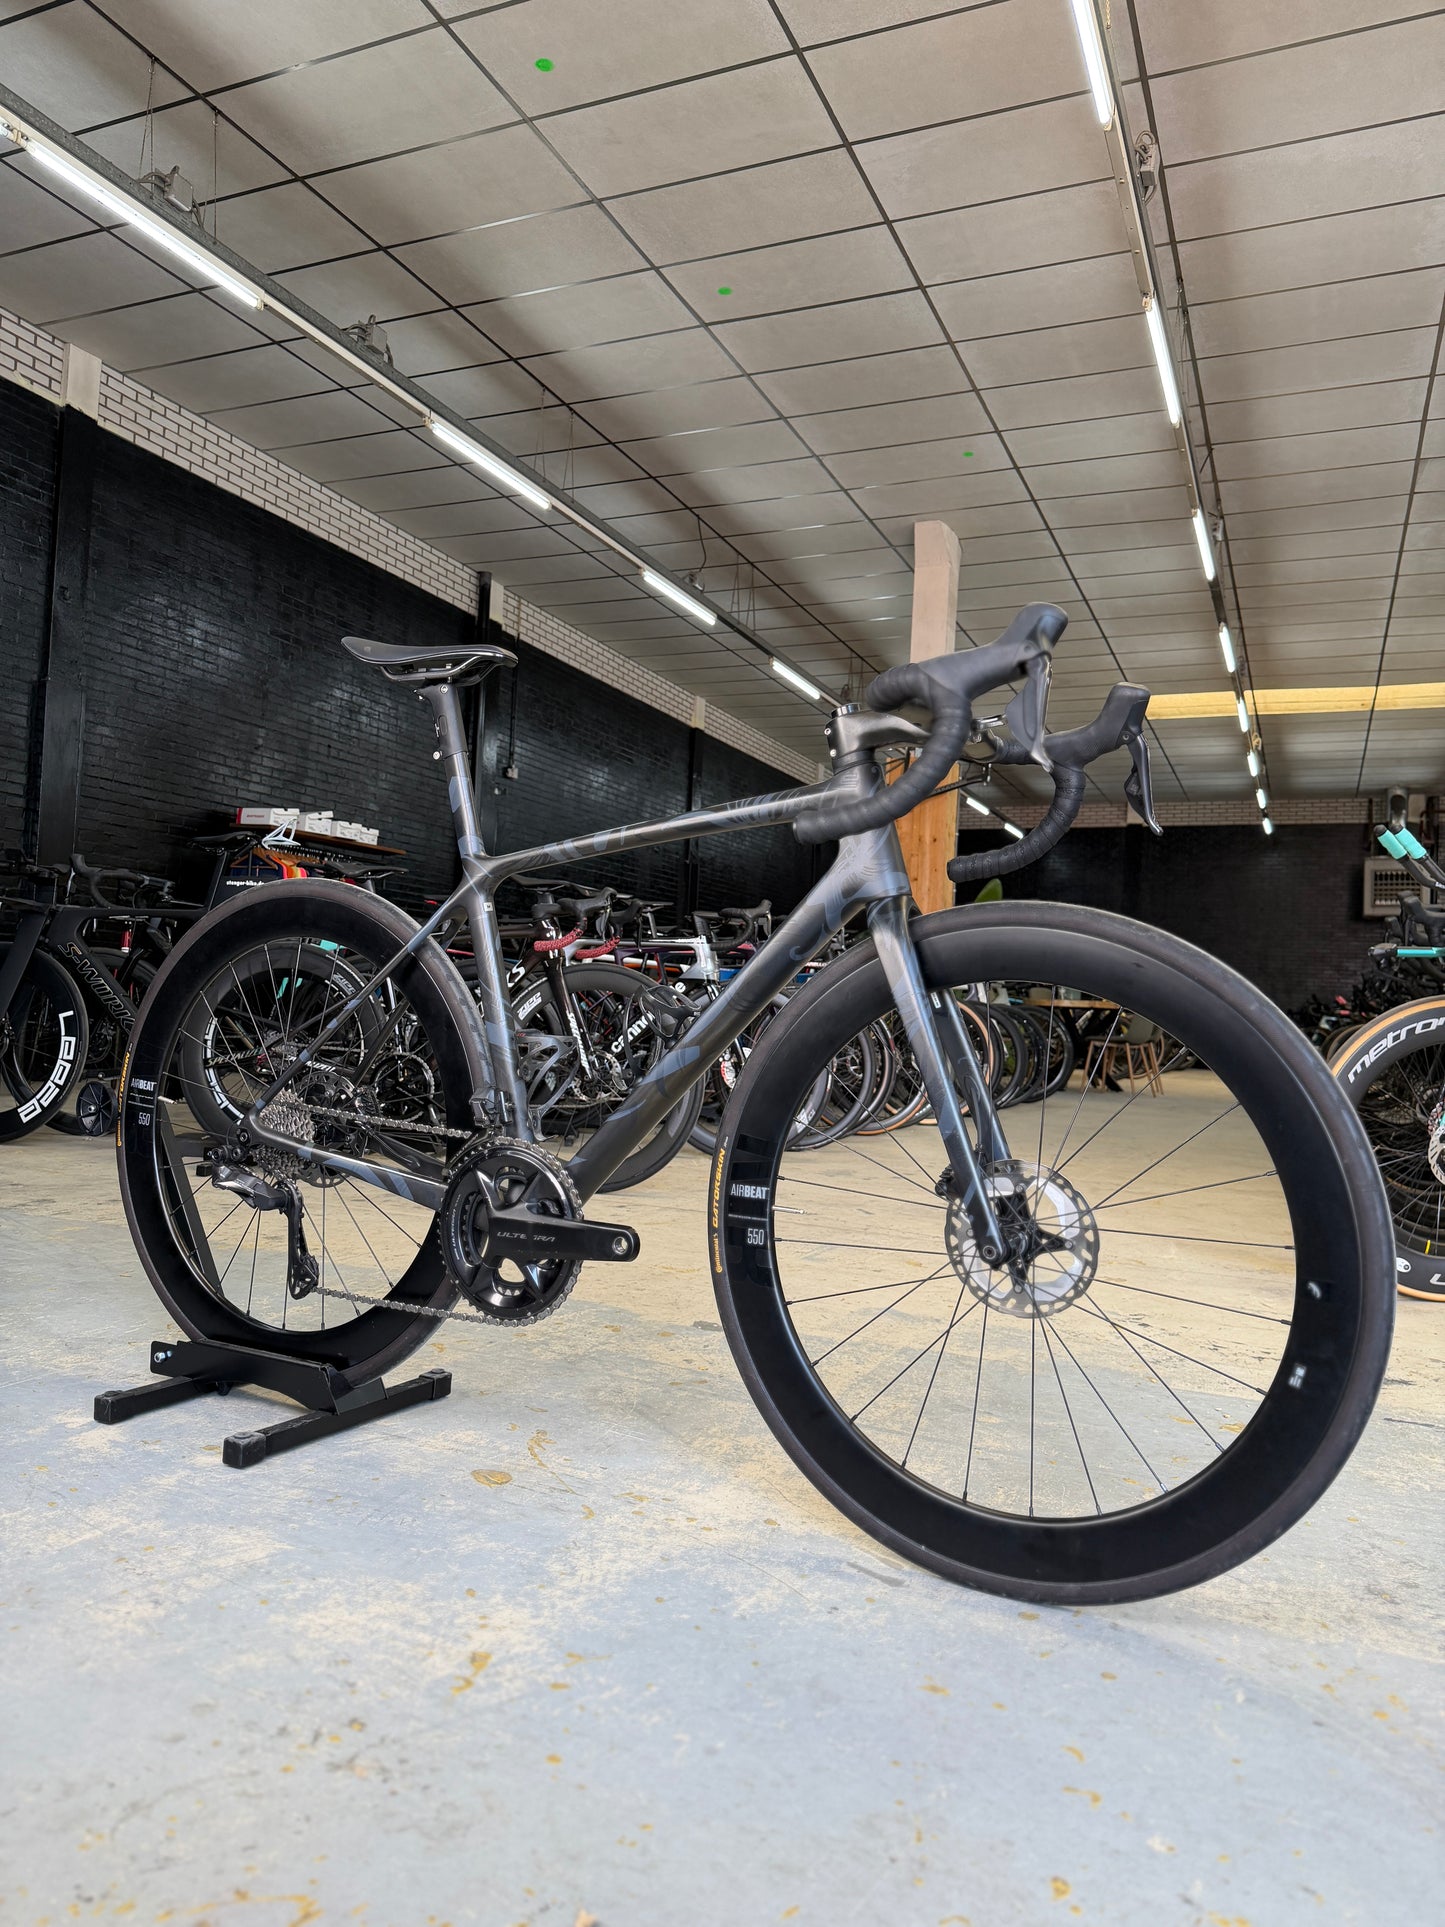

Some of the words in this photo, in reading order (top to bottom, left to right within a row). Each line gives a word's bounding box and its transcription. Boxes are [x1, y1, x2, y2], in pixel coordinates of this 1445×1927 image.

[58, 942, 136, 1035] S-WORK
[138, 1112, 151, 1126] 550
[712, 1148, 726, 1228] GATORSKIN
[730, 1183, 768, 1200] AIRBEAT
[747, 1228, 765, 1246] 550
